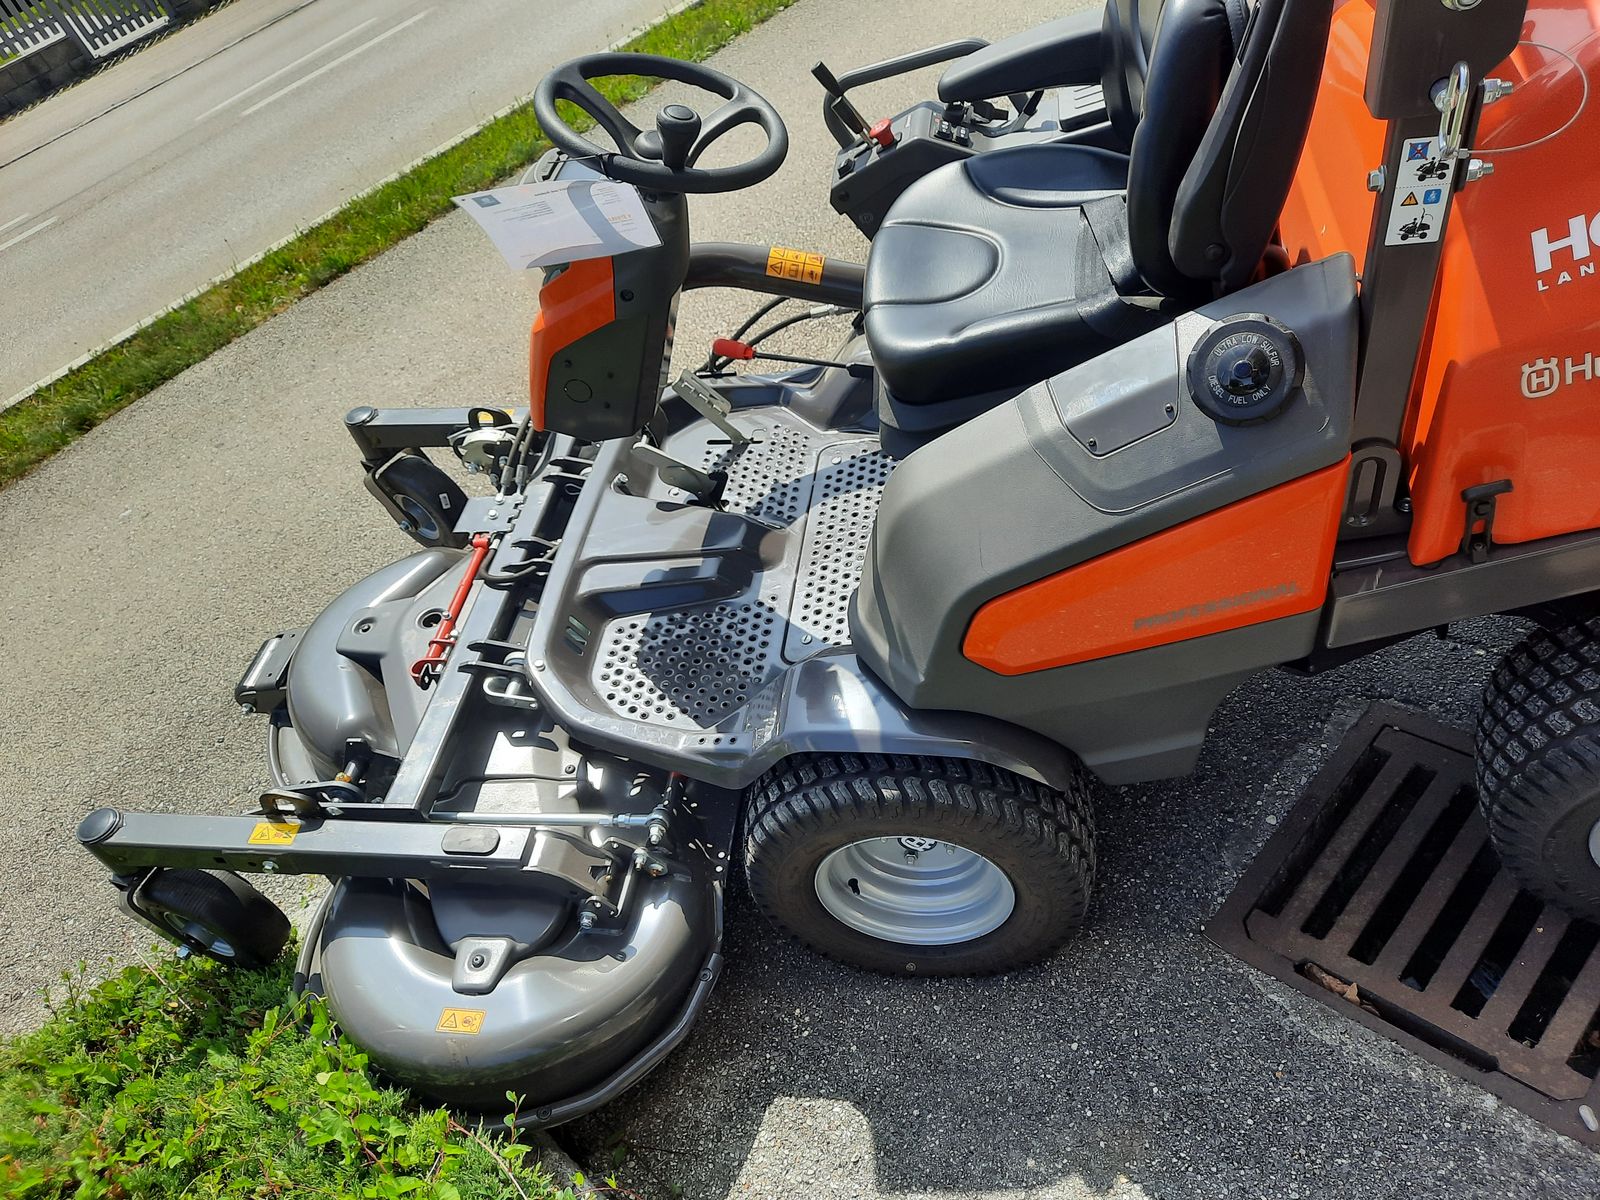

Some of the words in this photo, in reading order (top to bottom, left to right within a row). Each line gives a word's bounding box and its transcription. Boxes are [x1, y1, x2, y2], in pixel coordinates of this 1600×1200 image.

[1531, 210, 1600, 274] H
[1537, 261, 1596, 292] LAN
[1214, 336, 1238, 357] ULTRA
[1241, 334, 1259, 344] LOW
[1260, 340, 1280, 367] SULFUR
[1207, 375, 1224, 398] DIESEL
[1228, 394, 1248, 405] FUEL
[1252, 384, 1272, 401] ONLY
